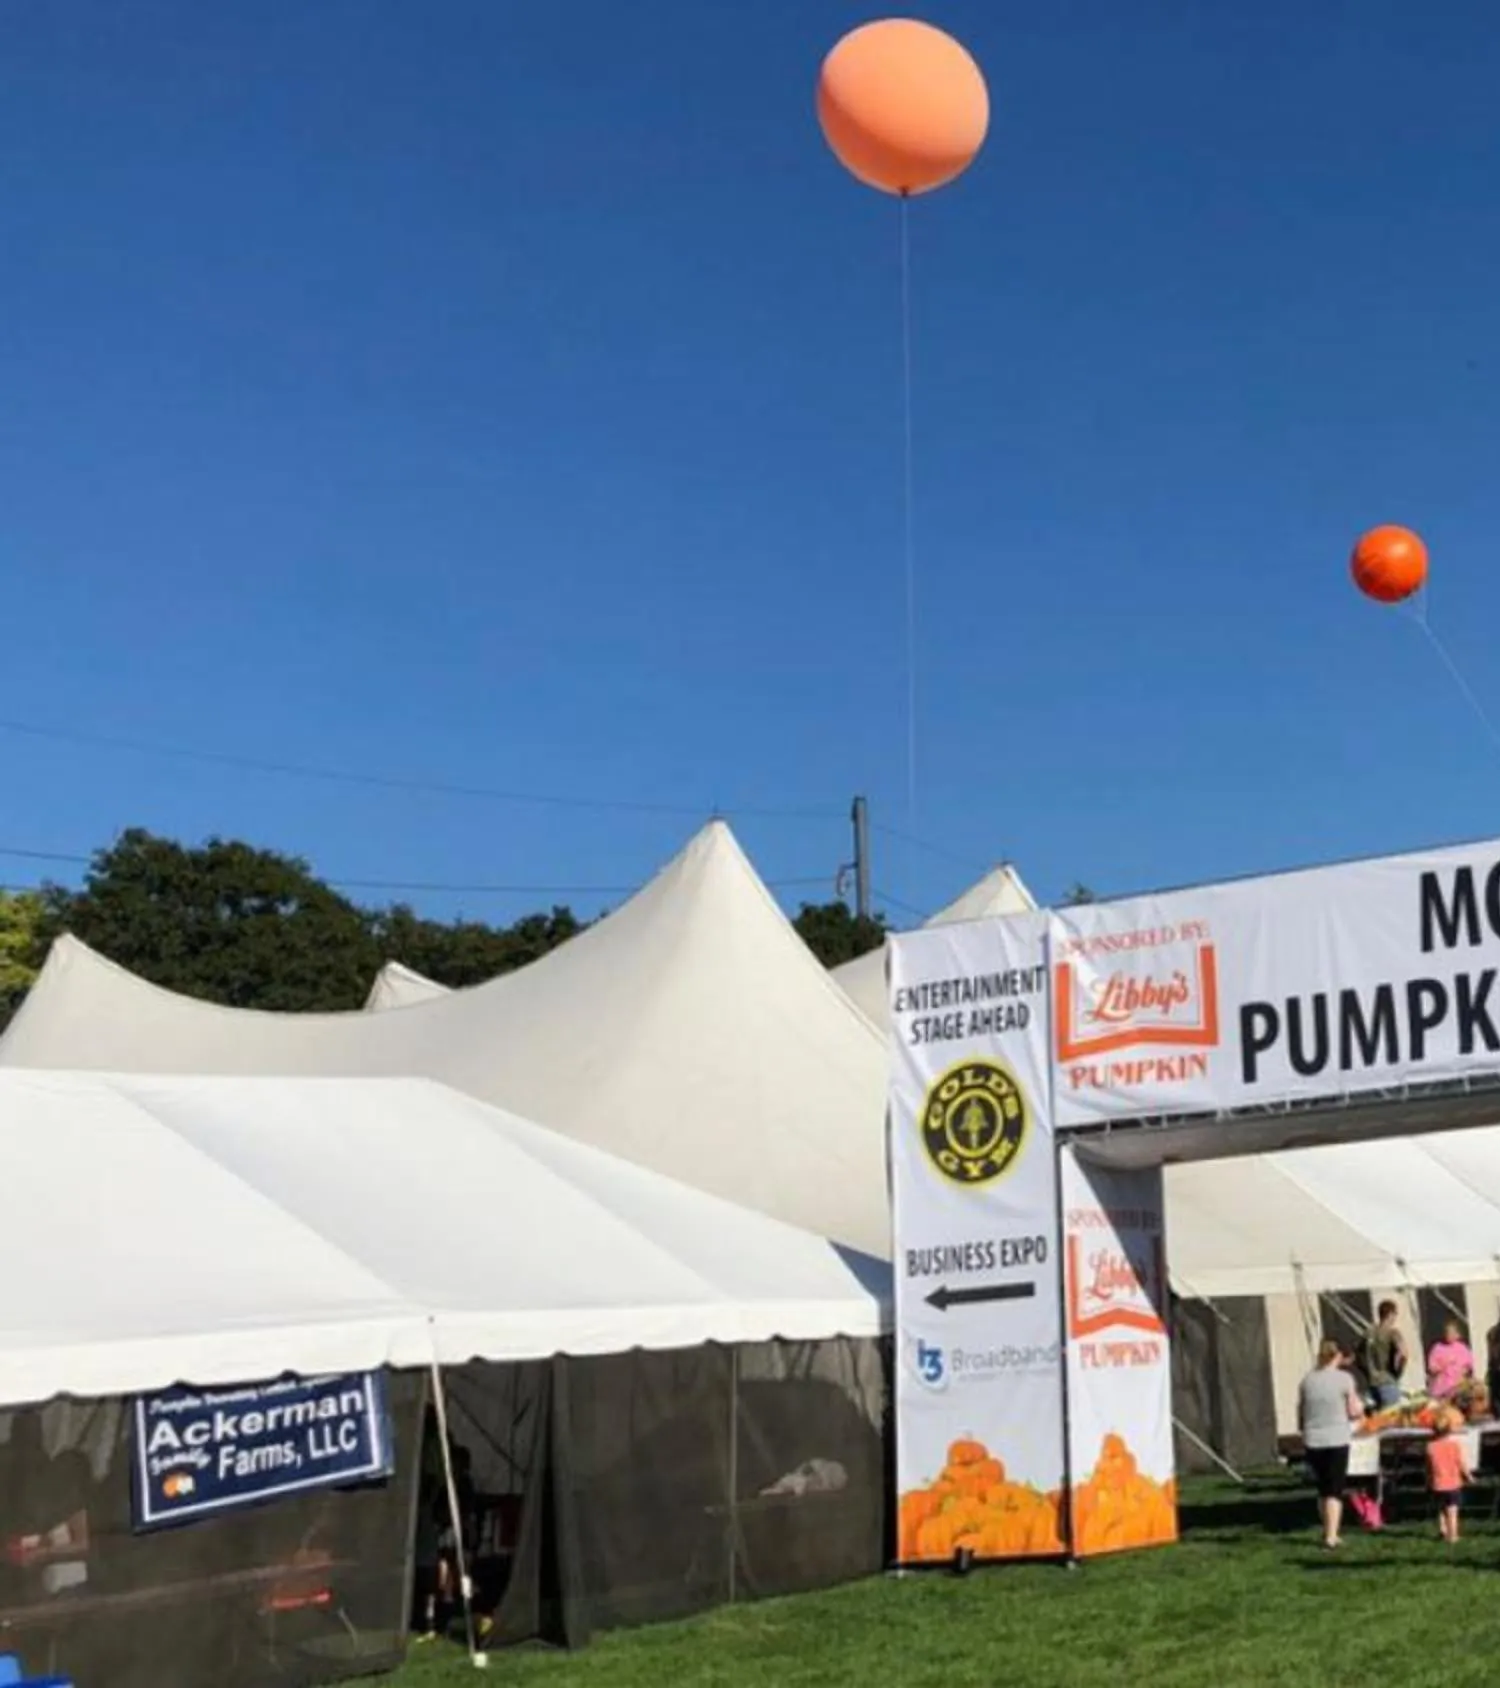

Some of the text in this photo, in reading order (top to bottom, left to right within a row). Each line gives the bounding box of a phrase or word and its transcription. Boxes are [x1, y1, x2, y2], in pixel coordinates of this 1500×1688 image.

[894, 964, 1047, 1013] ENTERTAINMENT
[1084, 969, 1190, 1023] Libby's
[910, 1002, 1031, 1046] STAGE AHEAD
[1069, 1054, 1208, 1091] PUMPKIN
[937, 1139, 1014, 1178] GYM
[906, 1234, 1048, 1278] BUSINESS EXPO
[951, 1340, 1058, 1372] Broadband
[1080, 1340, 1161, 1370] PUMPKIN
[148, 1388, 365, 1453] Ackerman
[217, 1418, 359, 1481] Farms, LLC
